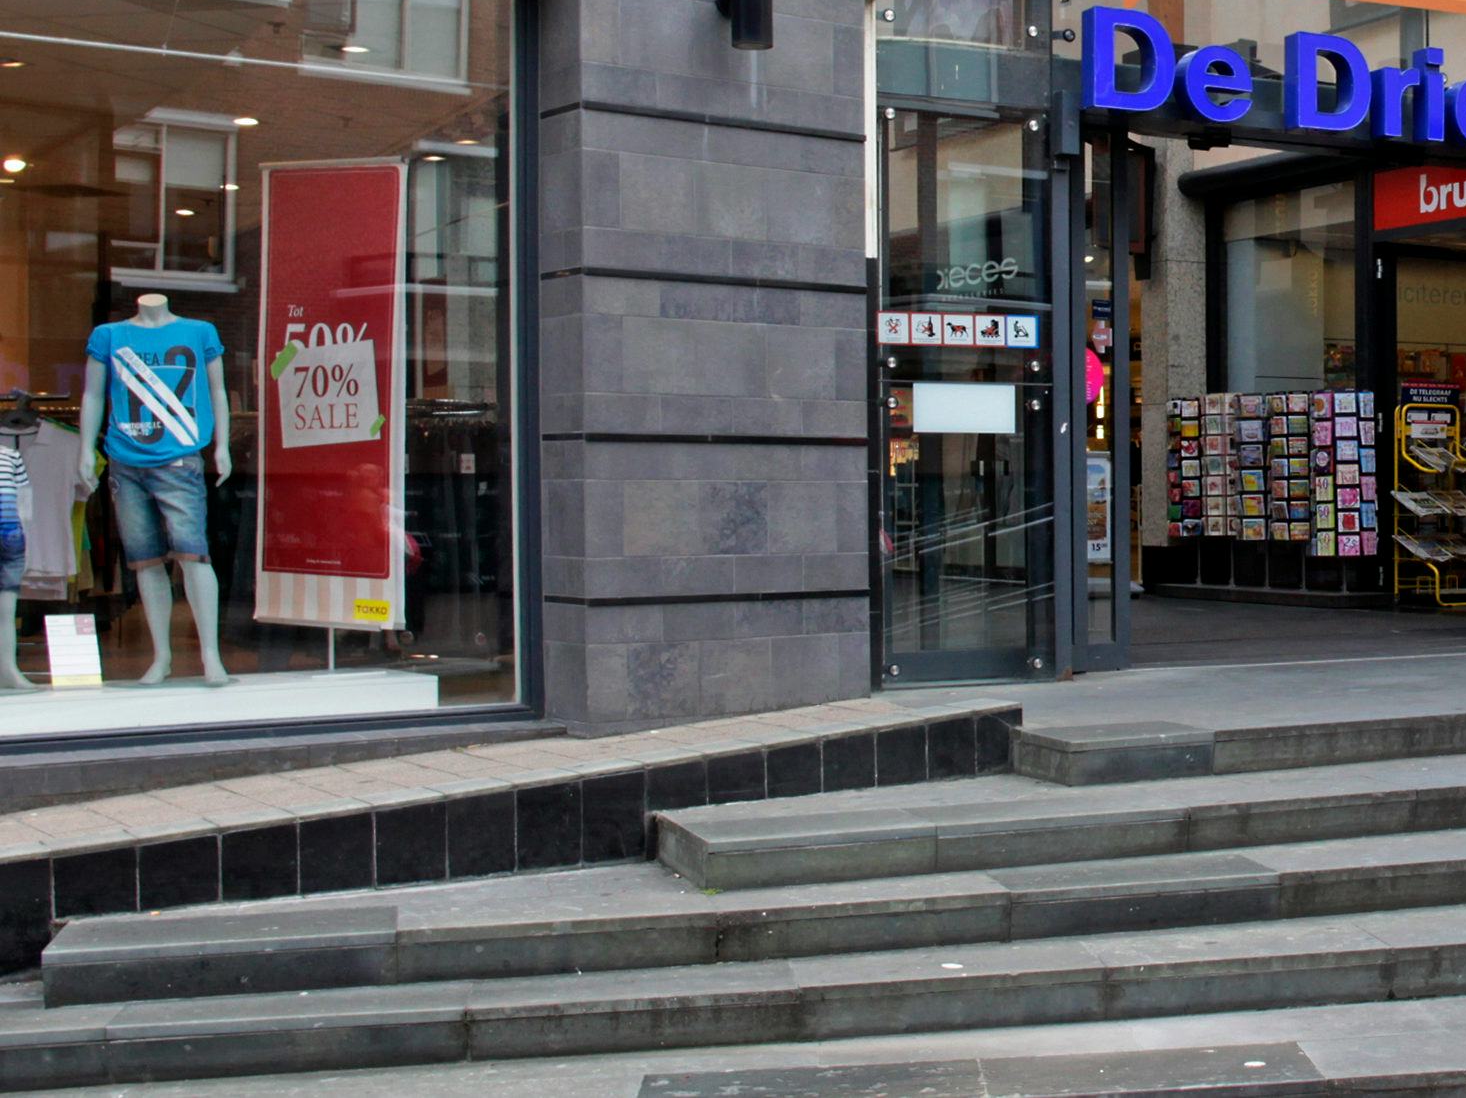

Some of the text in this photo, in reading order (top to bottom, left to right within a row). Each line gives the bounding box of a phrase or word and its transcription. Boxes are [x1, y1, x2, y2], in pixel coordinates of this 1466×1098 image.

[1082, 4, 1254, 123] De
[288, 304, 304, 317] Tot
[294, 363, 360, 399] 70%
[294, 403, 360, 431] SALE
